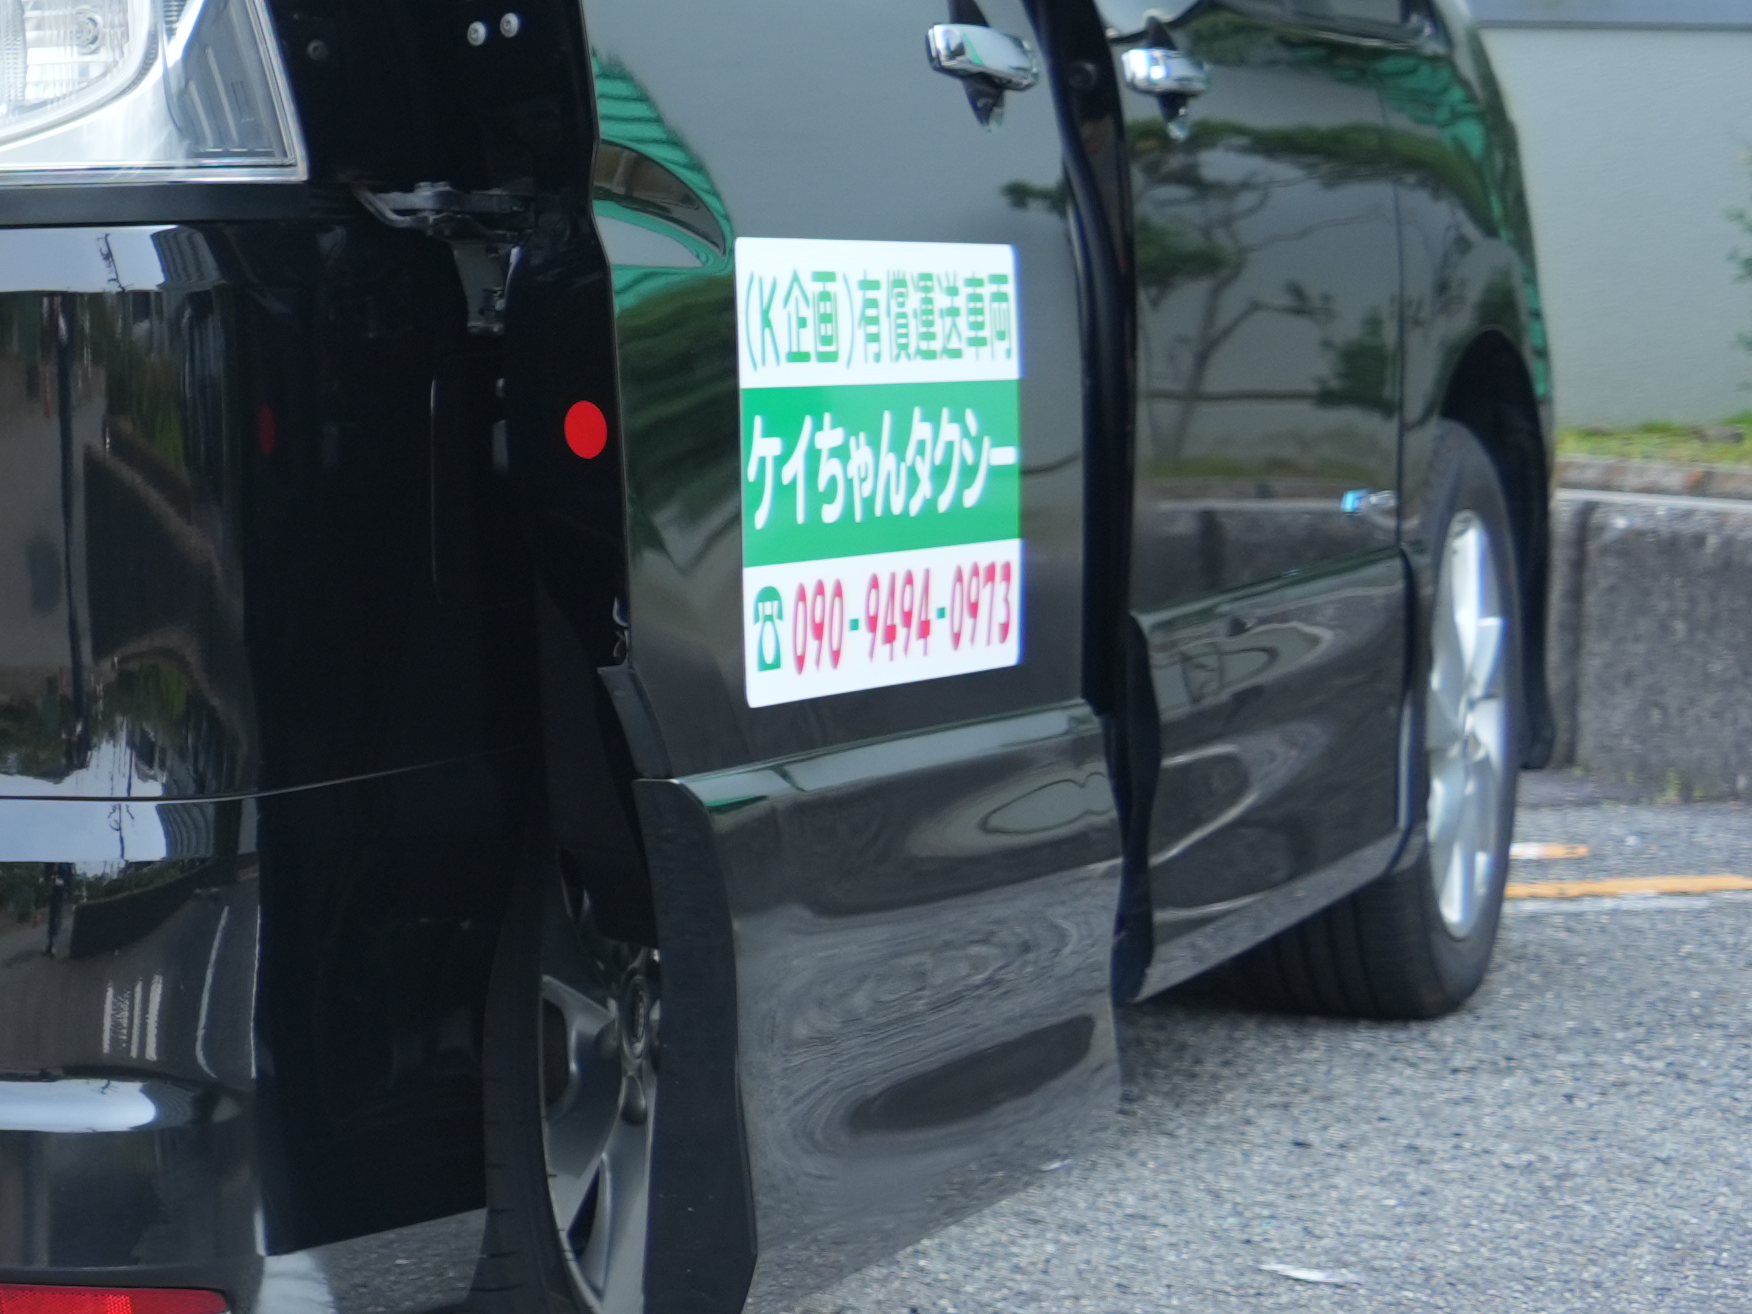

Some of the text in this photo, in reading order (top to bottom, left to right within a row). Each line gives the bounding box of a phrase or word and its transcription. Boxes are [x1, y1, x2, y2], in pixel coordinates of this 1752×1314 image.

[746, 406, 1018, 531] ケイちゃんタクシー
[791, 560, 1013, 676] 090-9494-0973
